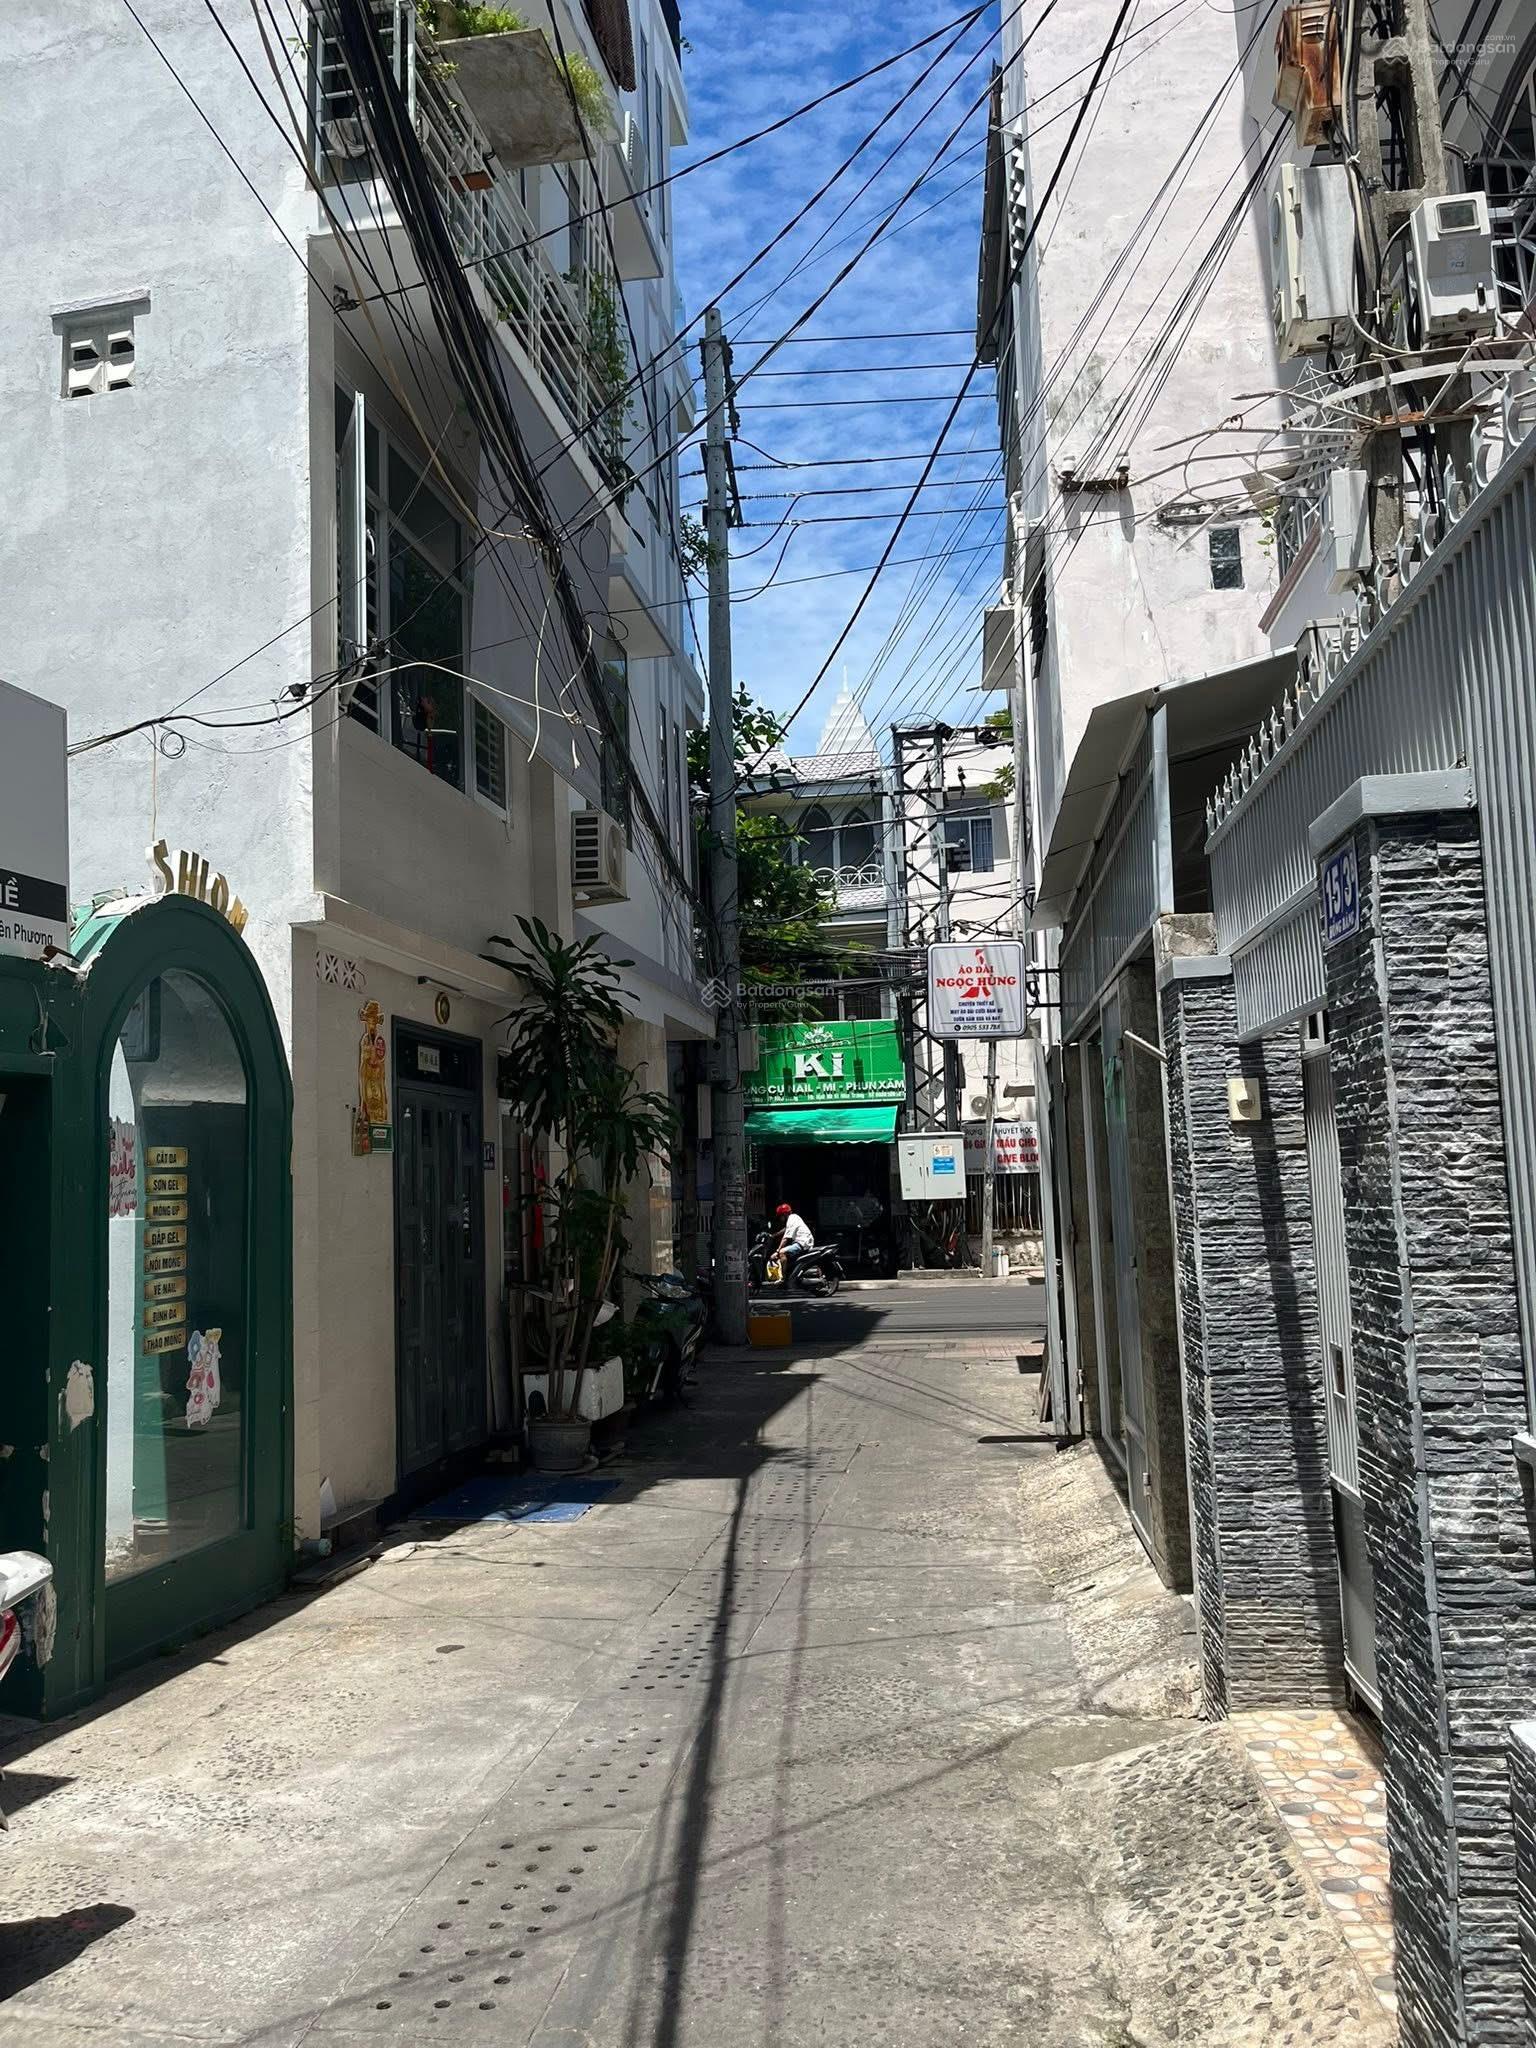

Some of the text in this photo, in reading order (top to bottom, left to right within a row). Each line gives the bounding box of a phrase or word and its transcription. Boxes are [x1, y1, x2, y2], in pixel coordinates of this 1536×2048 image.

[936, 978, 974, 990] NGỌC
[788, 1084, 813, 1094] NAIL
[823, 1083, 836, 1092] MI
[846, 1082, 877, 1091] PHUN
[878, 1078, 904, 1090] XĂM
[1019, 1138, 1037, 1148] CHO
[997, 1154, 1018, 1164] GIVE
[168, 1180, 179, 1190] GEL
[167, 1232, 179, 1243] GEL
